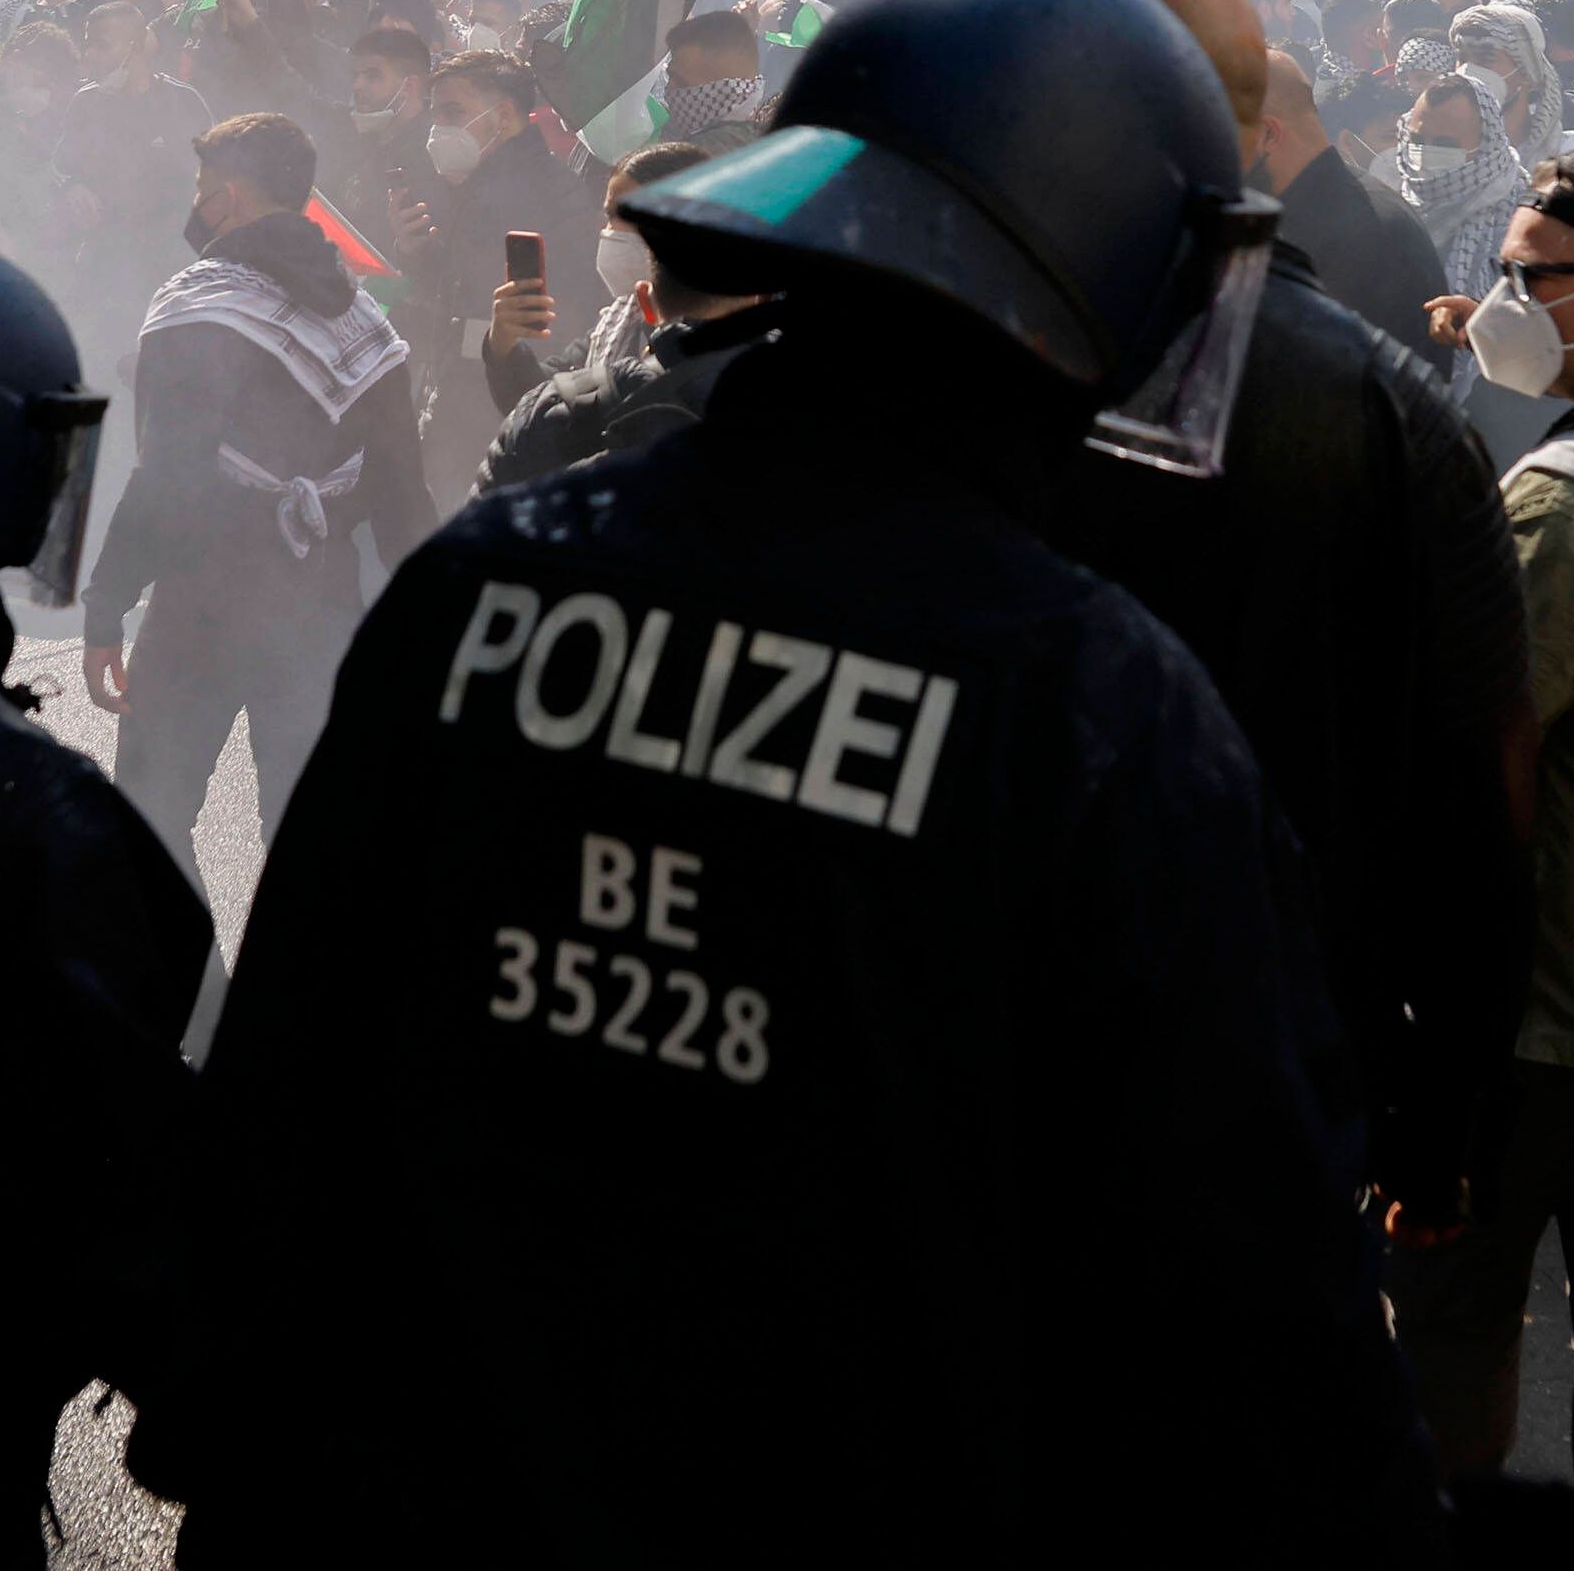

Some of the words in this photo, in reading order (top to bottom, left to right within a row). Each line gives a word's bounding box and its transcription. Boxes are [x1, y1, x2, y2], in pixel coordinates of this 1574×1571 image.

[438, 580, 960, 837] POLIZEI
[579, 832, 705, 950] BE
[488, 927, 772, 1085] 35228
